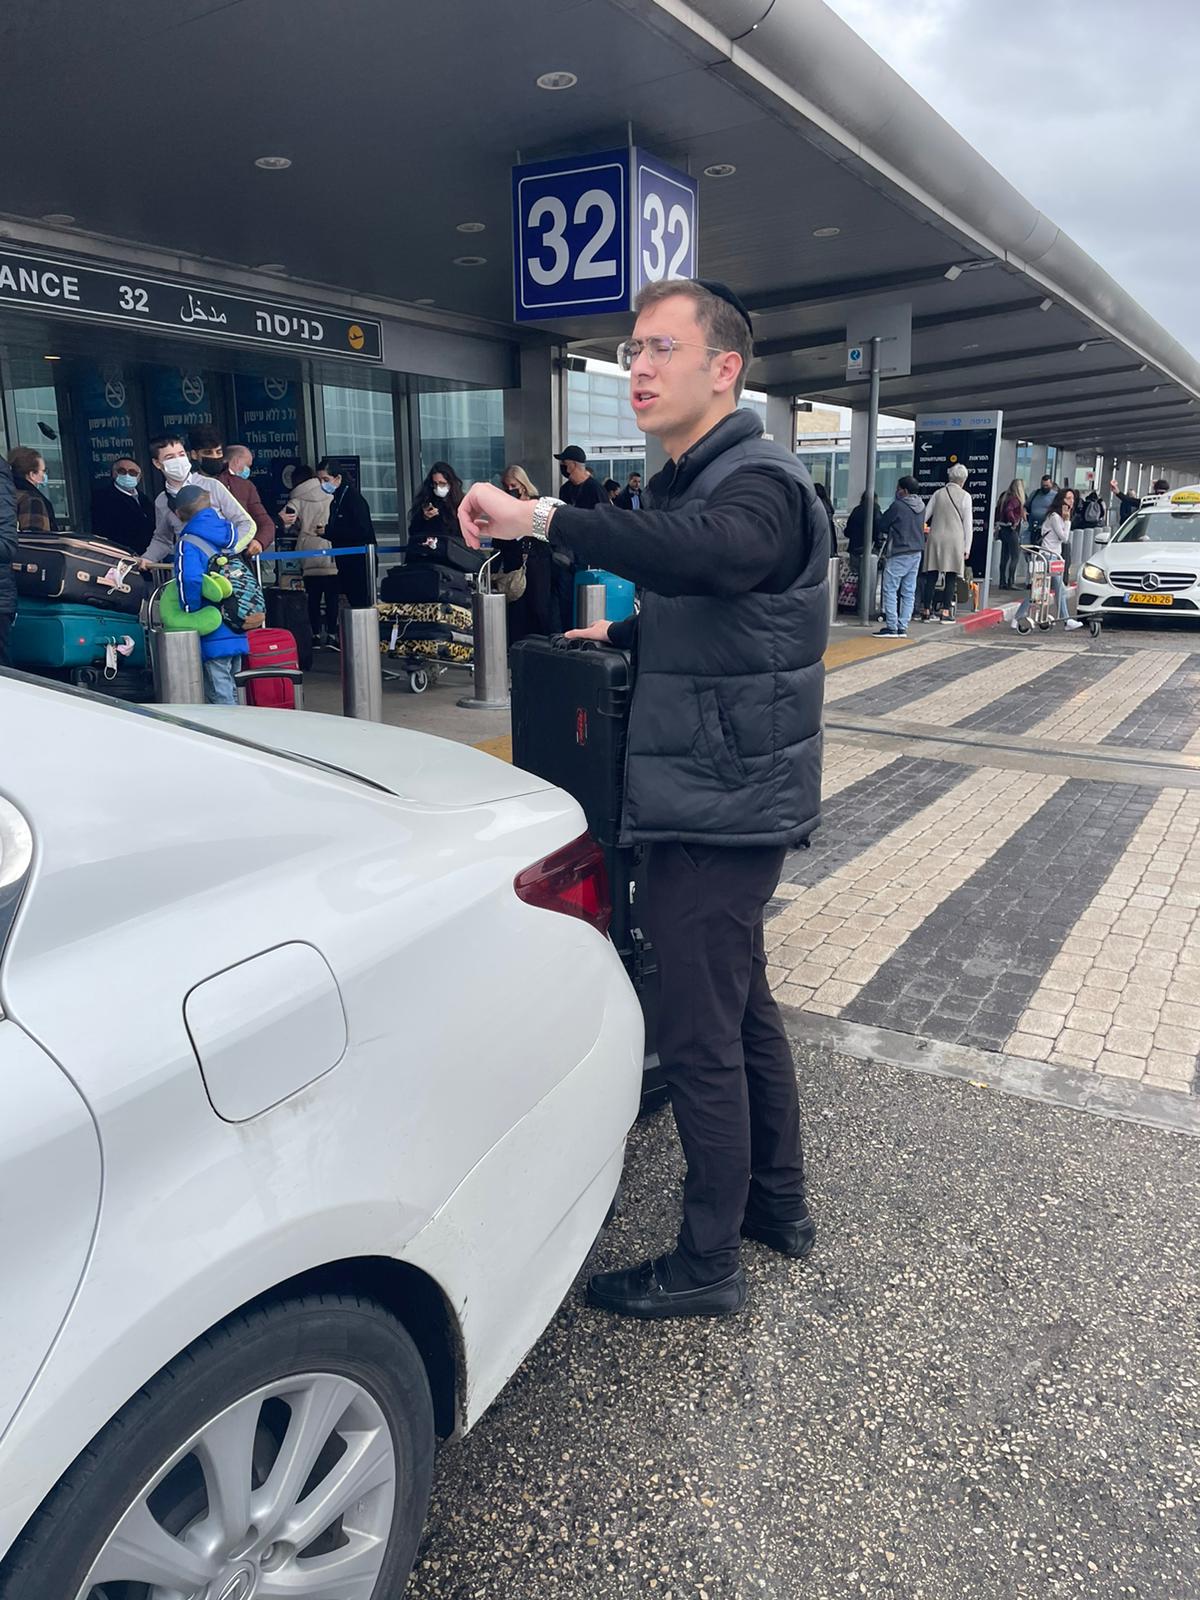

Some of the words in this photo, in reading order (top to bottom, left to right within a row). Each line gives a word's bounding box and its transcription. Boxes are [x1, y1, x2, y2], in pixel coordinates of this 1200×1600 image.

[527, 188, 617, 286] 32
[642, 192, 690, 283] 32
[0, 265, 80, 301] ANCE
[118, 285, 150, 313] 32
[180, 294, 227, 325] مدخل
[255, 310, 324, 342] כניסה
[90, 437, 109, 448] This
[110, 437, 134, 448] Term
[245, 431, 267, 443] This
[257, 446, 292, 458] smoke
[92, 451, 100, 462] is
